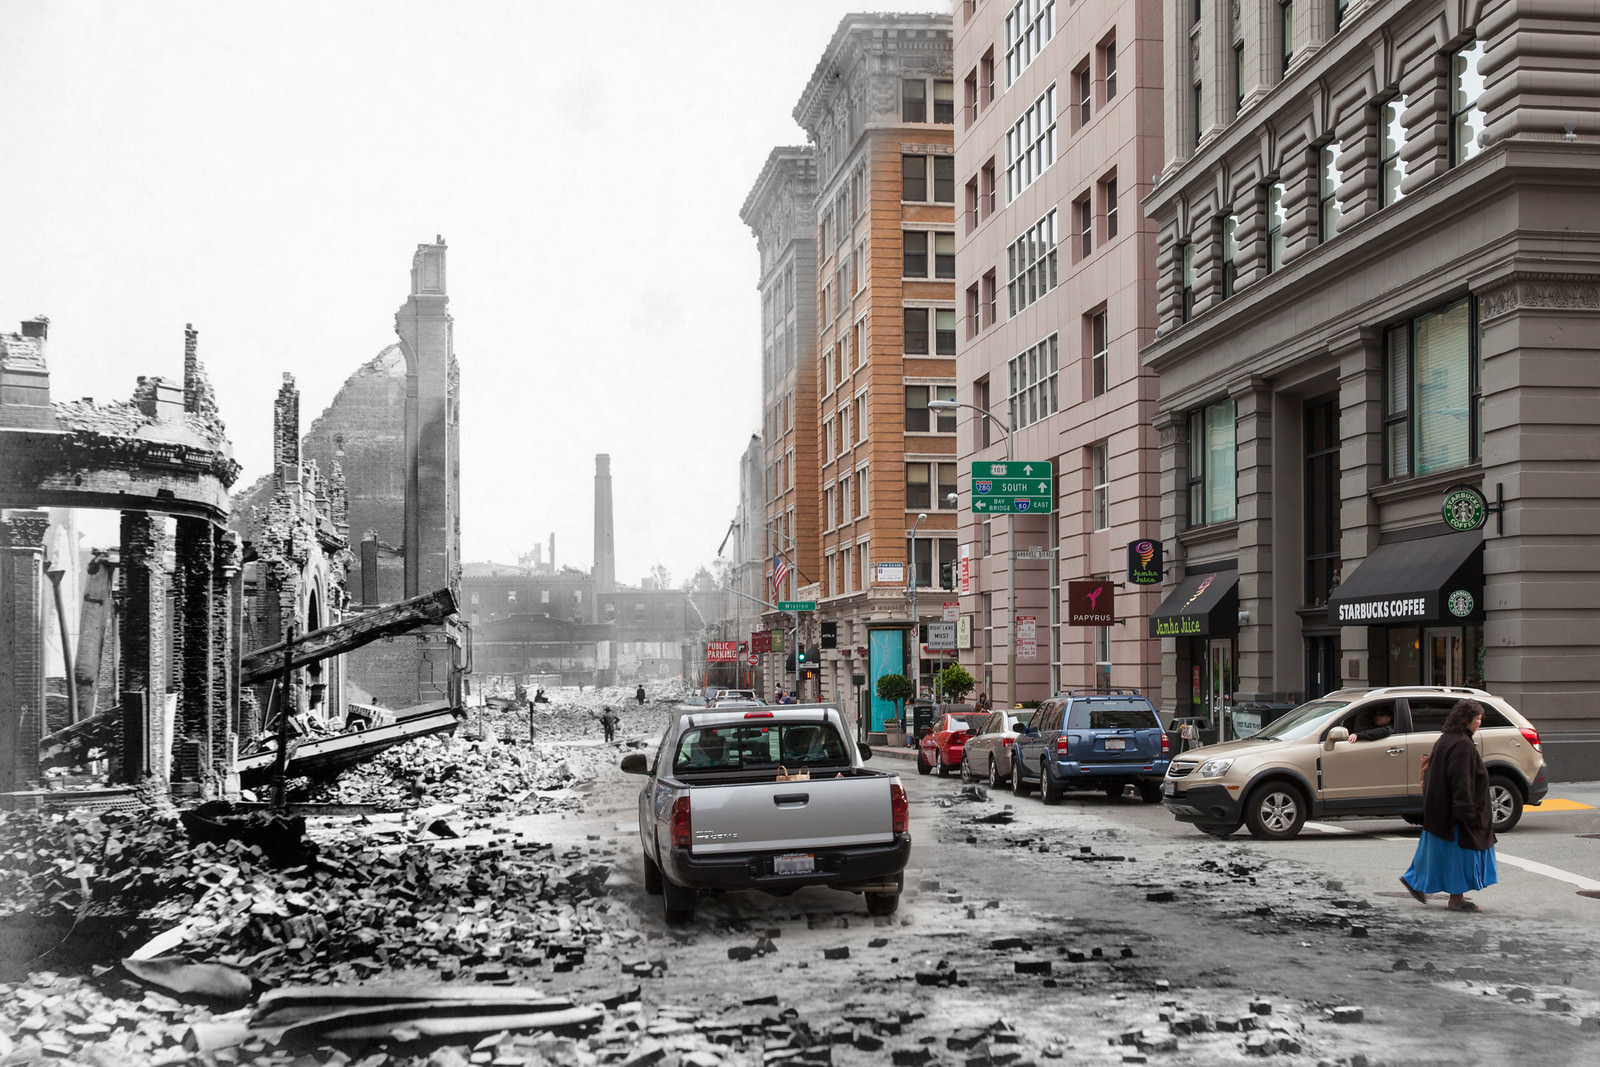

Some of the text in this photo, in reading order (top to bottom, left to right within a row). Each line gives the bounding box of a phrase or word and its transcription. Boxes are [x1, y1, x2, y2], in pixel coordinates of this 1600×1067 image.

[1002, 483, 1027, 492] SOUTH
[1446, 492, 1480, 509] STARBUCKS
[1450, 518, 1477, 528] COFFEE
[1339, 598, 1425, 620] STARBUCKS COFFEE
[1156, 616, 1201, 635] Jamba Juice
[707, 650, 737, 658] PARKING
